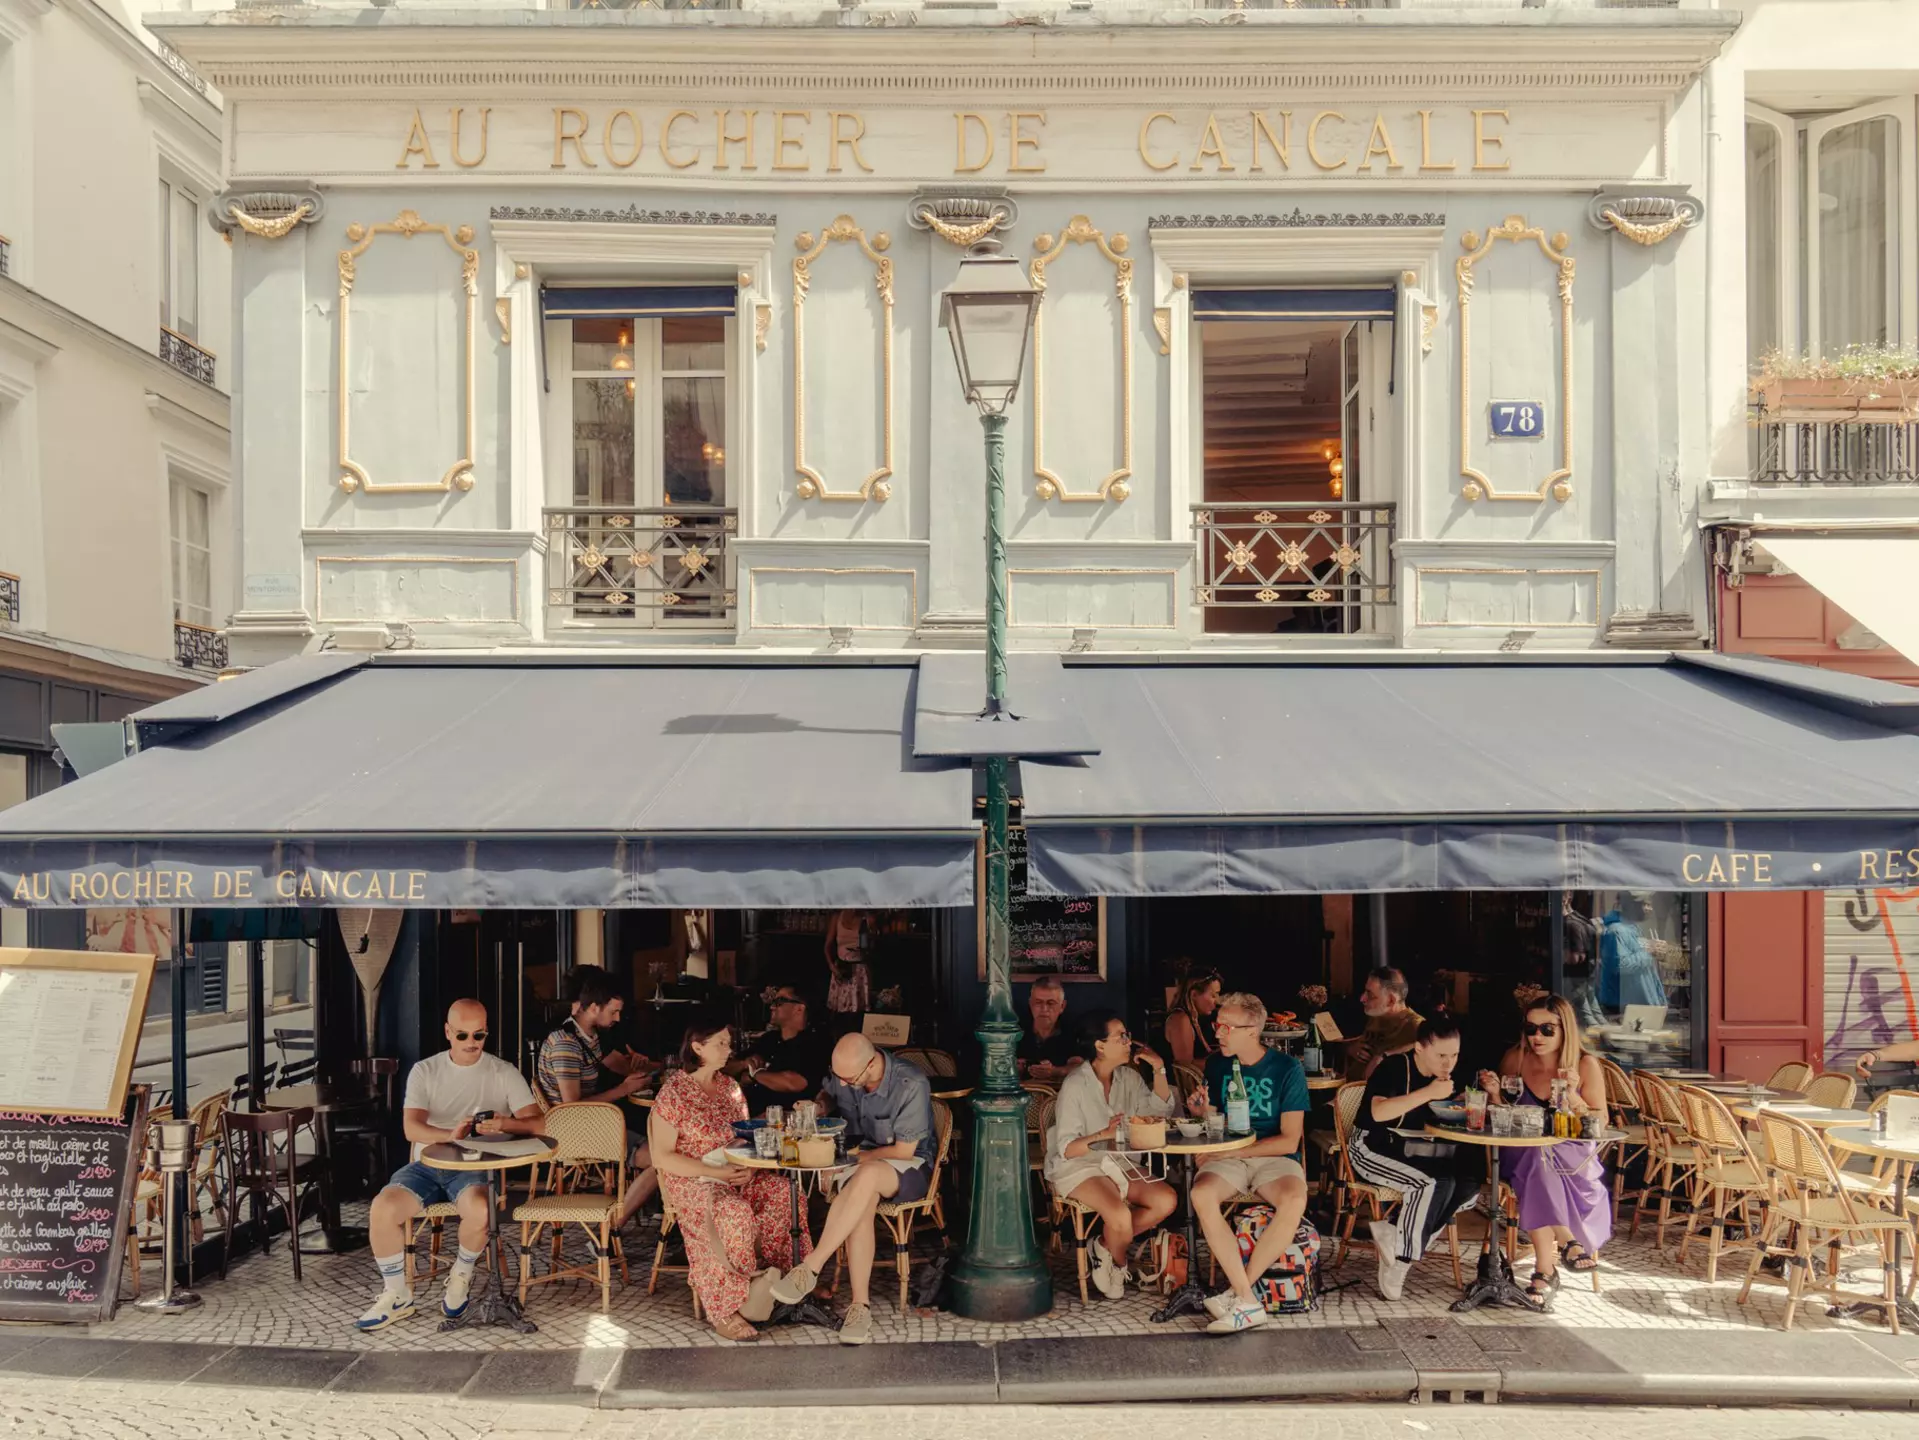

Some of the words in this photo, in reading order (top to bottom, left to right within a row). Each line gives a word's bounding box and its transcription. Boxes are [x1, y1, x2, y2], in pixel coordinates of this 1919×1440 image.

[396, 107, 491, 168] AU
[551, 107, 874, 173] ROCHER
[953, 111, 1047, 173] DE
[1139, 110, 1511, 172] CANCALE
[1500, 406, 1535, 433] 78
[265, 577, 279, 585] RUE
[1682, 852, 1773, 883] CAFE
[1859, 848, 1919, 880] RES
[13, 872, 51, 900] AU
[70, 871, 196, 900] ROCHER
[213, 870, 253, 899] DE
[275, 870, 428, 900] CANCALE
[12, 1135, 27, 1150] de
[92, 1137, 110, 1152] de
[17, 1149, 29, 1164] et
[92, 1152, 109, 1167] de
[11, 1182, 25, 1198] de
[82, 1186, 114, 1199] sauce
[19, 1222, 32, 1238] de
[36, 1221, 76, 1239] Gambas
